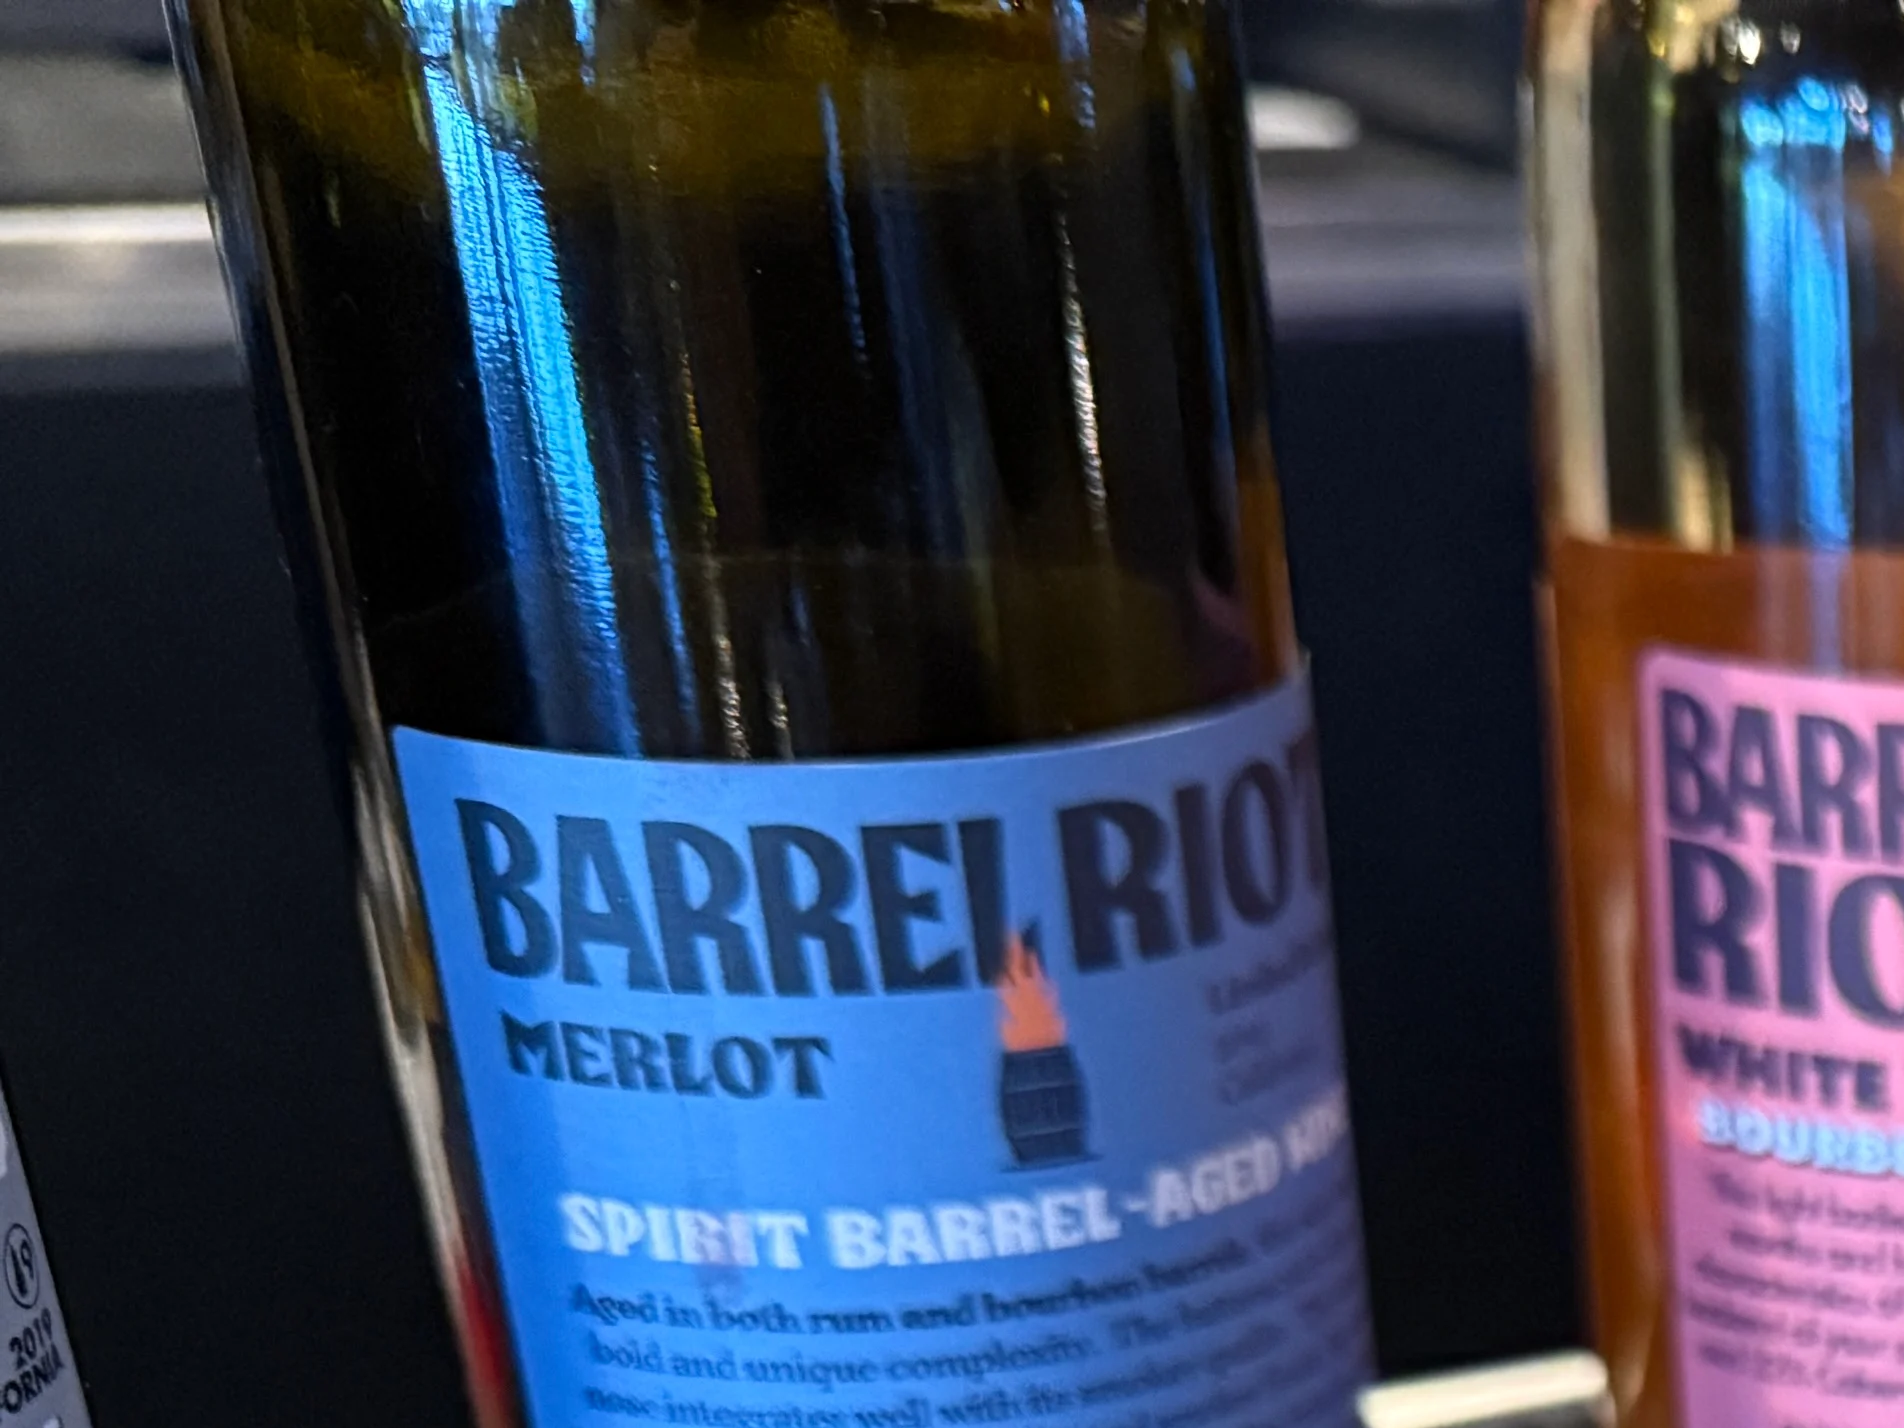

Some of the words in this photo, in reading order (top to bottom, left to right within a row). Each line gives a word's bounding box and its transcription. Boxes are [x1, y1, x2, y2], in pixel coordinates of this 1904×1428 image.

[453, 796, 1042, 998] BARREL
[500, 1009, 835, 1099] MERLOT
[1675, 1025, 1888, 1114] WHITE
[558, 1193, 810, 1269] SPIRIT
[9, 1308, 52, 1371] 2019
[671, 1346, 737, 1381] and
